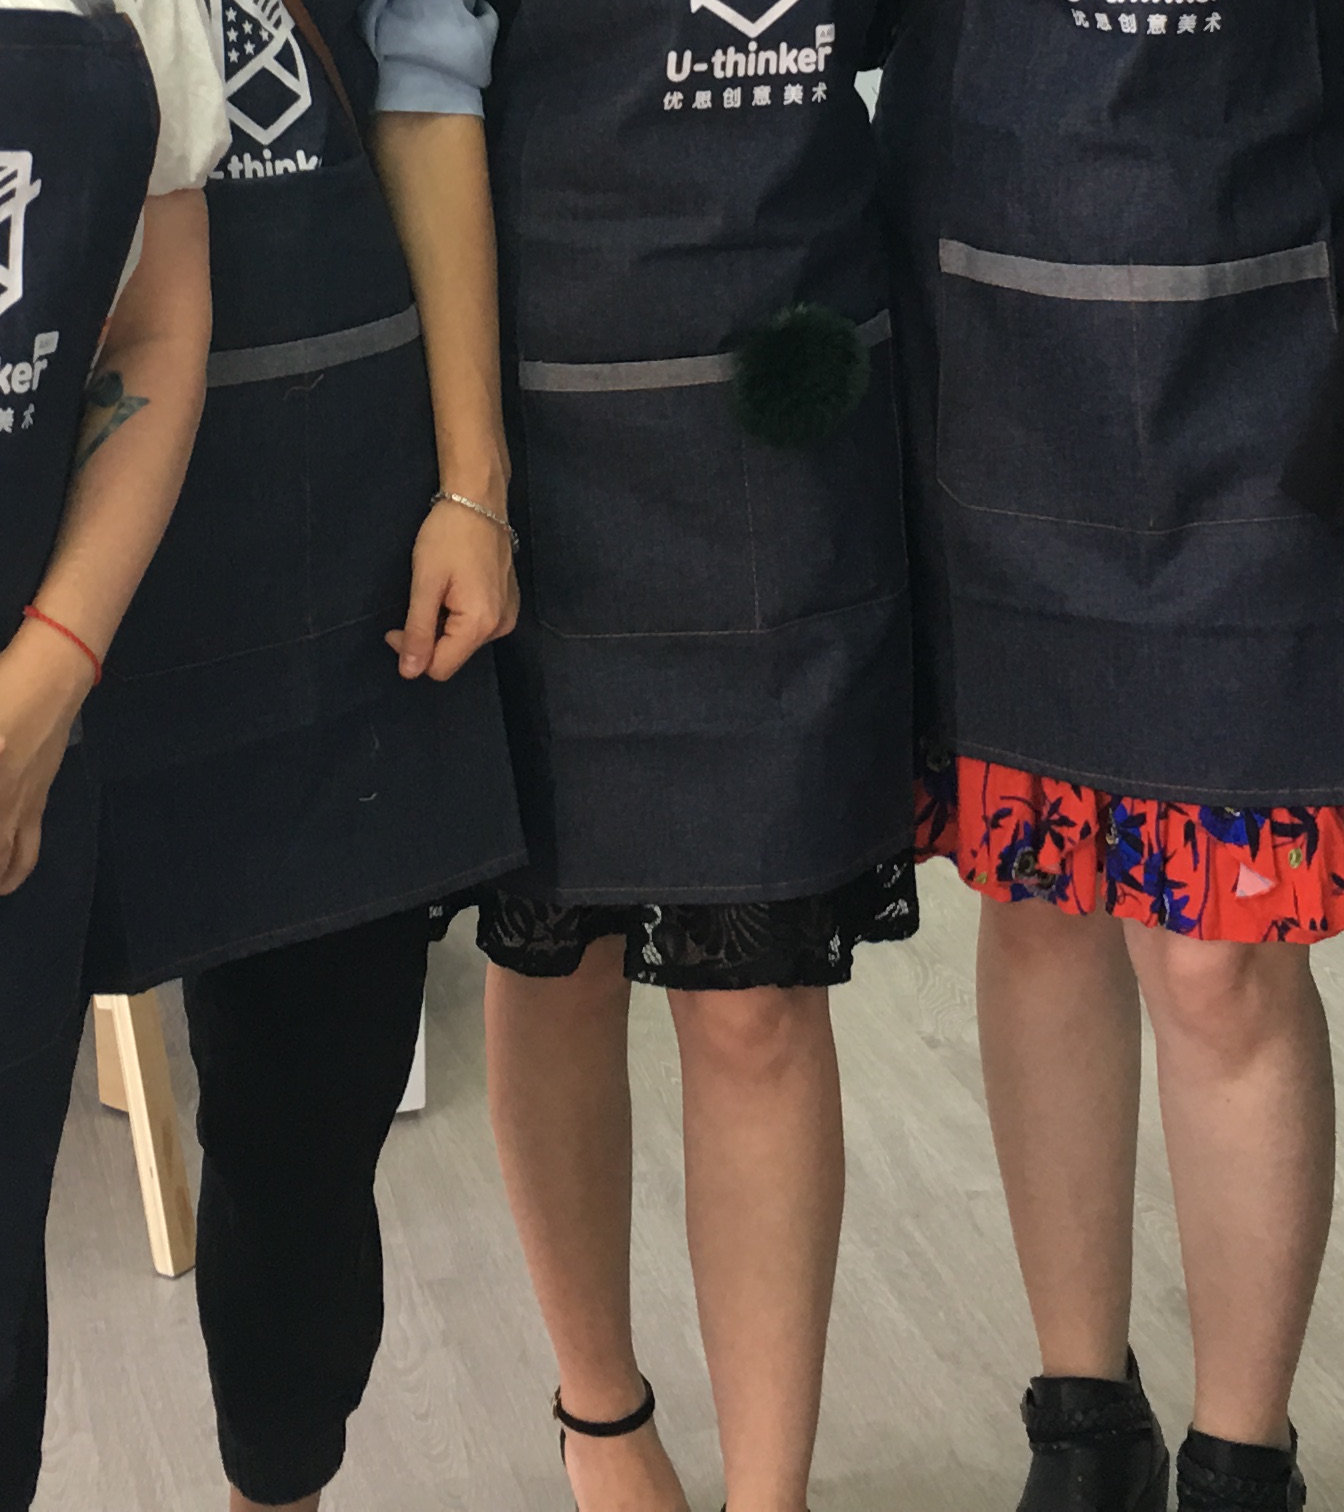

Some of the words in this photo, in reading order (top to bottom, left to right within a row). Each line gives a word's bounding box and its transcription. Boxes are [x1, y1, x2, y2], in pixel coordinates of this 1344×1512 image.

[666, 41, 832, 82] U-thinker
[663, 82, 828, 110] 优思创意美术
[207, 149, 323, 179] -think
